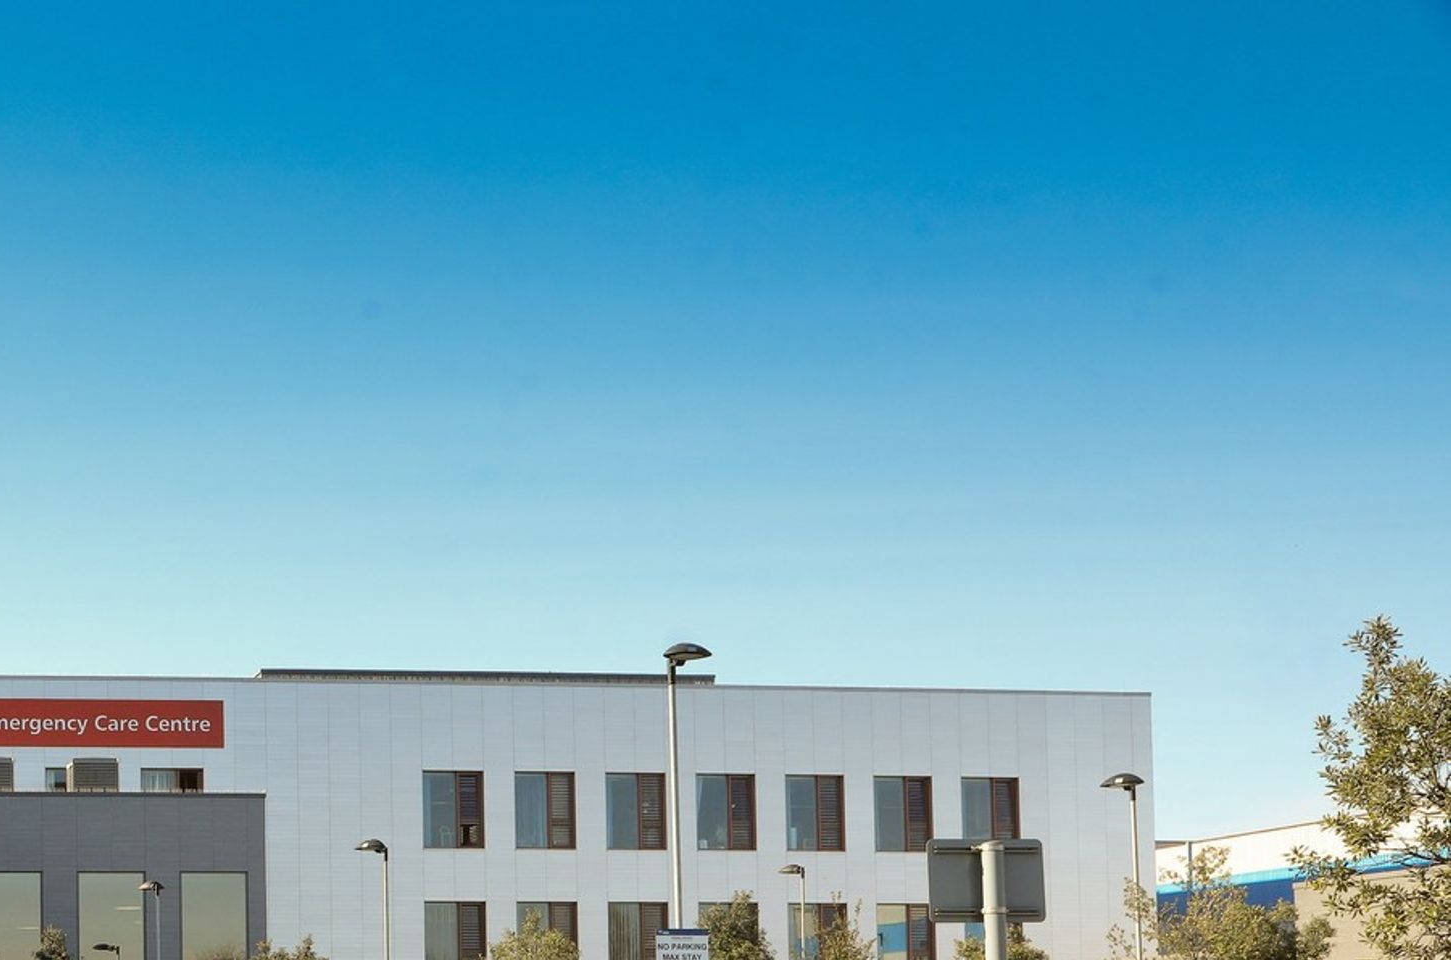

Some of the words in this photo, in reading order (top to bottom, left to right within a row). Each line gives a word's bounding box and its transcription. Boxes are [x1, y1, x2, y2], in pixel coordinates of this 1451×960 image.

[94, 715, 139, 732] Care
[145, 715, 211, 732] Centre
[658, 943, 670, 951] NO
[671, 943, 707, 951] PARKING
[662, 953, 680, 960] MAX
[681, 953, 702, 960] STAY
